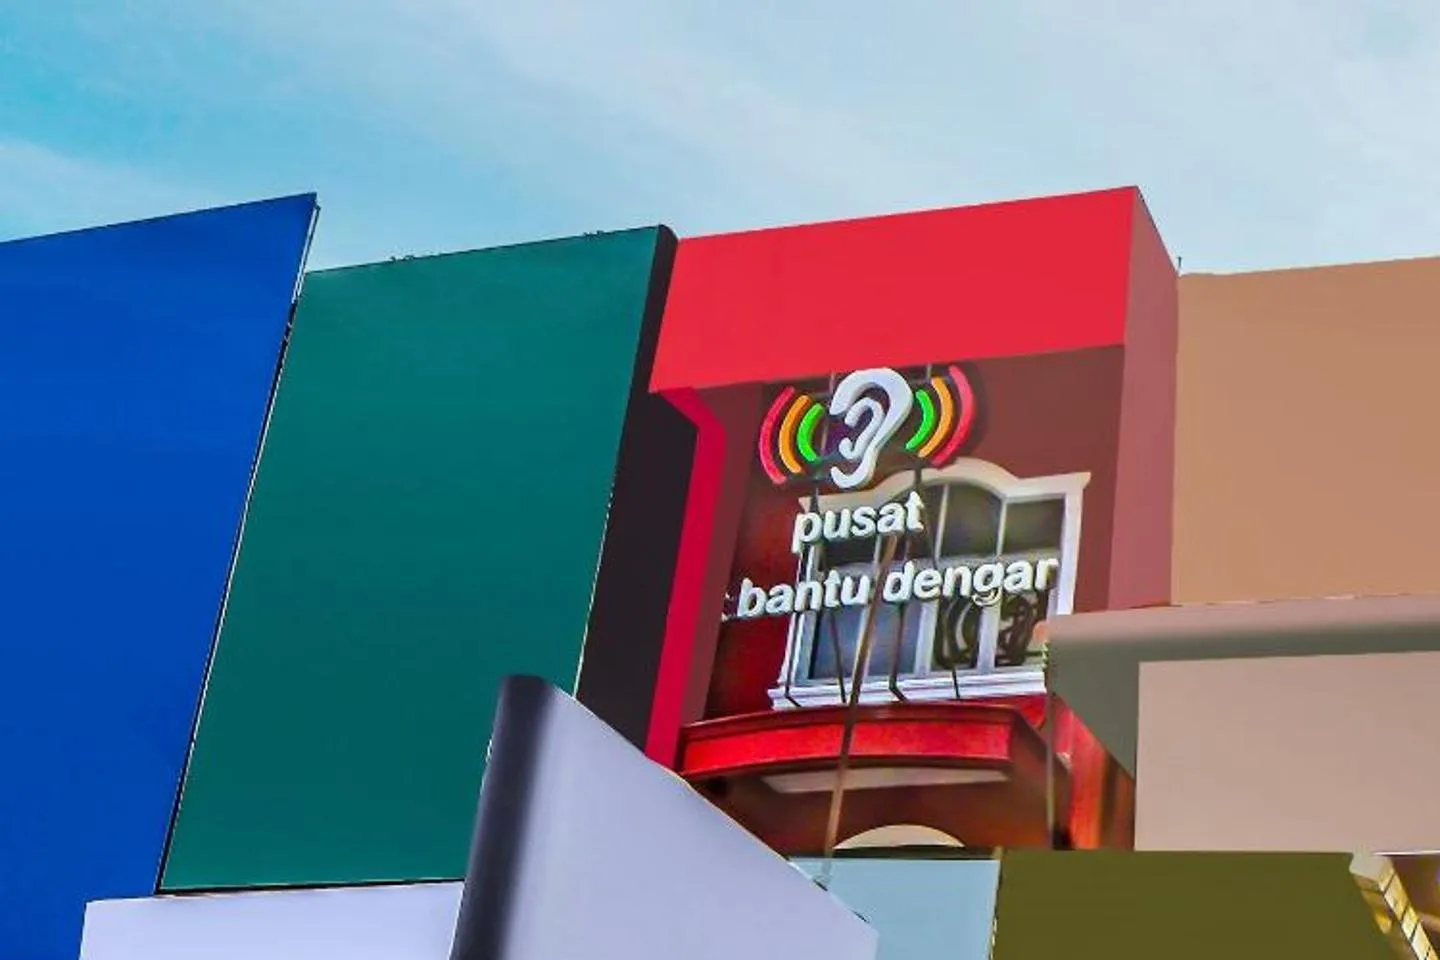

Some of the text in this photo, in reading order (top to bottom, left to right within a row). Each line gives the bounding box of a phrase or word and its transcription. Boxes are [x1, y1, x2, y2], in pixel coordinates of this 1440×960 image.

[791, 490, 924, 554] pusat
[736, 557, 1059, 618] bantu dengar
